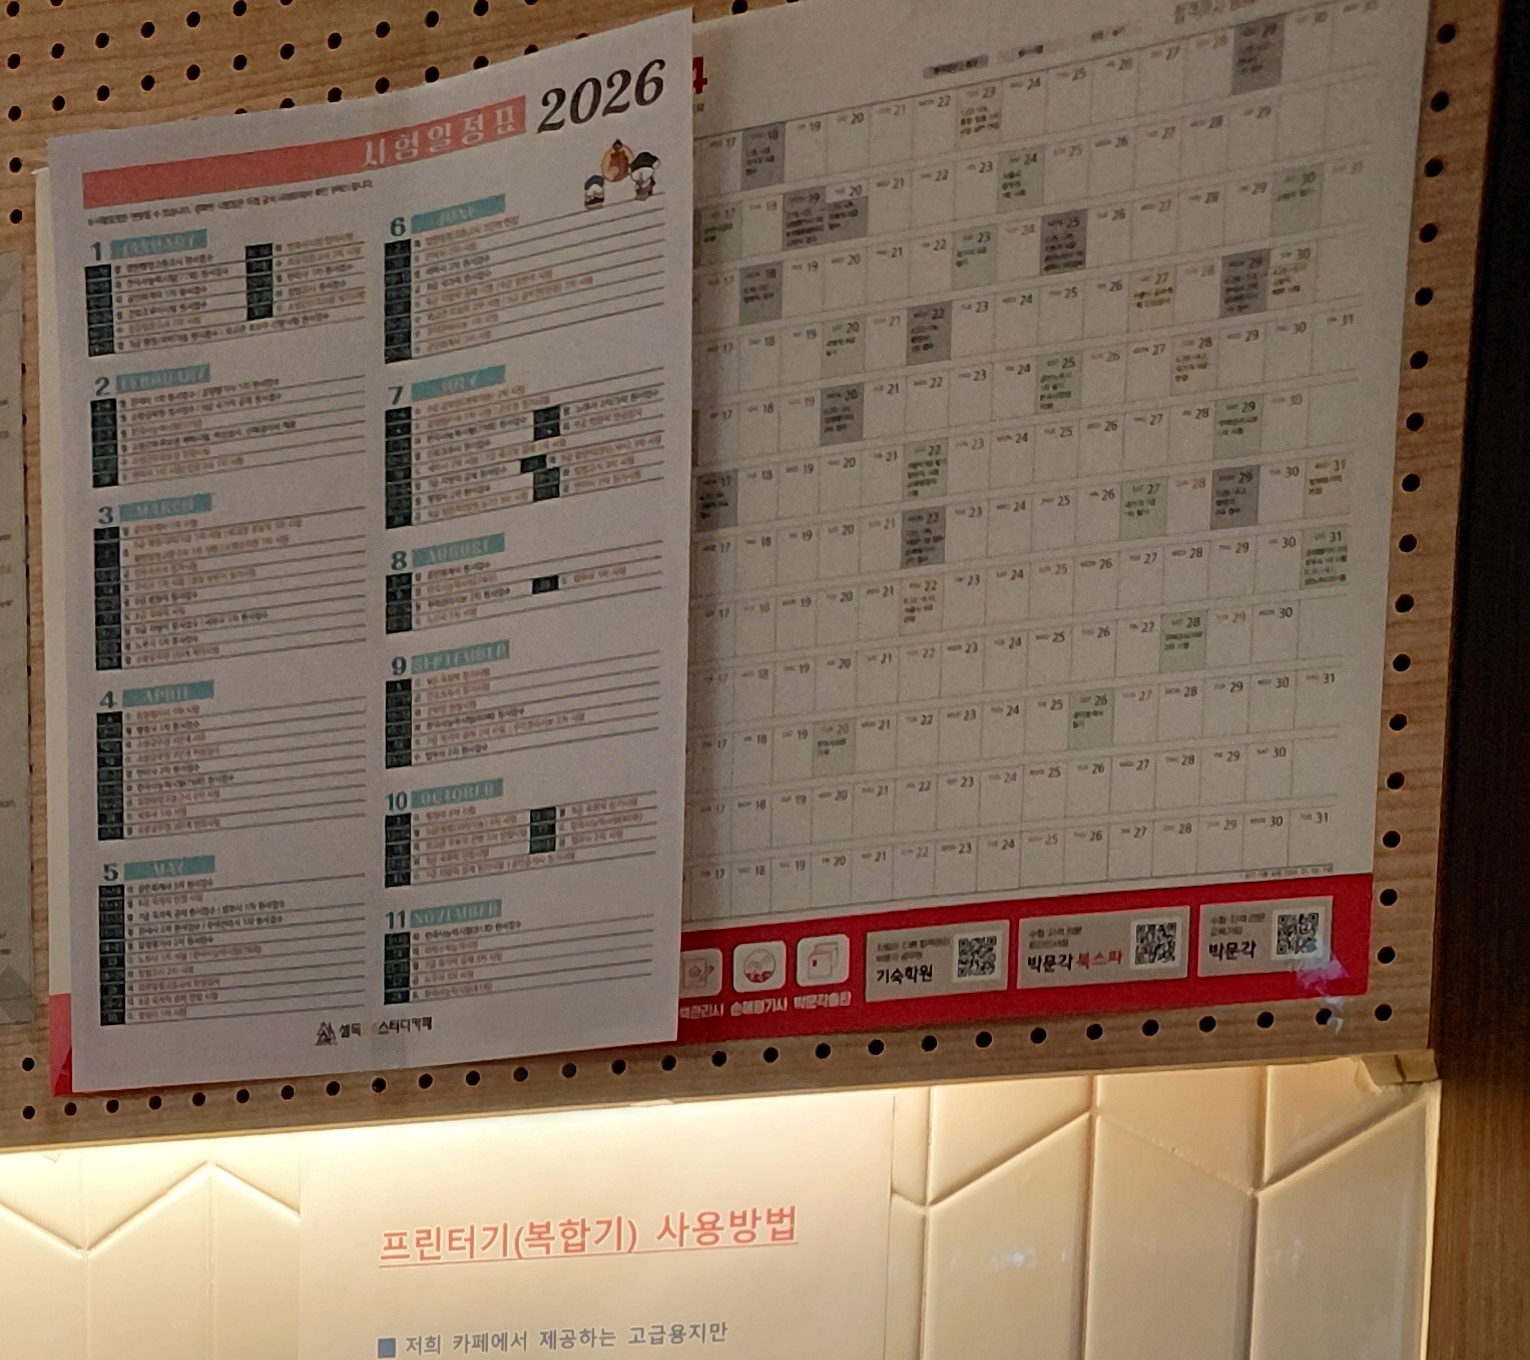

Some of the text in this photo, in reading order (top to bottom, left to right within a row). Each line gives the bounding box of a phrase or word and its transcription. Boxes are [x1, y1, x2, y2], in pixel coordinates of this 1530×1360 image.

[537, 59, 667, 134] 2026
[360, 105, 518, 168] 시험일정표
[390, 217, 406, 236] 6
[90, 242, 102, 260] 1
[94, 376, 110, 396] 2
[388, 386, 403, 405] 7
[98, 506, 114, 524] 3
[392, 550, 407, 570] 8
[392, 656, 406, 676] 9
[99, 690, 116, 708] 4
[385, 792, 408, 811] 10
[103, 863, 118, 881] 5
[385, 911, 406, 929] 11
[380, 1205, 797, 1260] 프린터기(복합기) 사용방법
[405, 1322, 728, 1356] 저희 카페에서 제공하는 고급용지만
